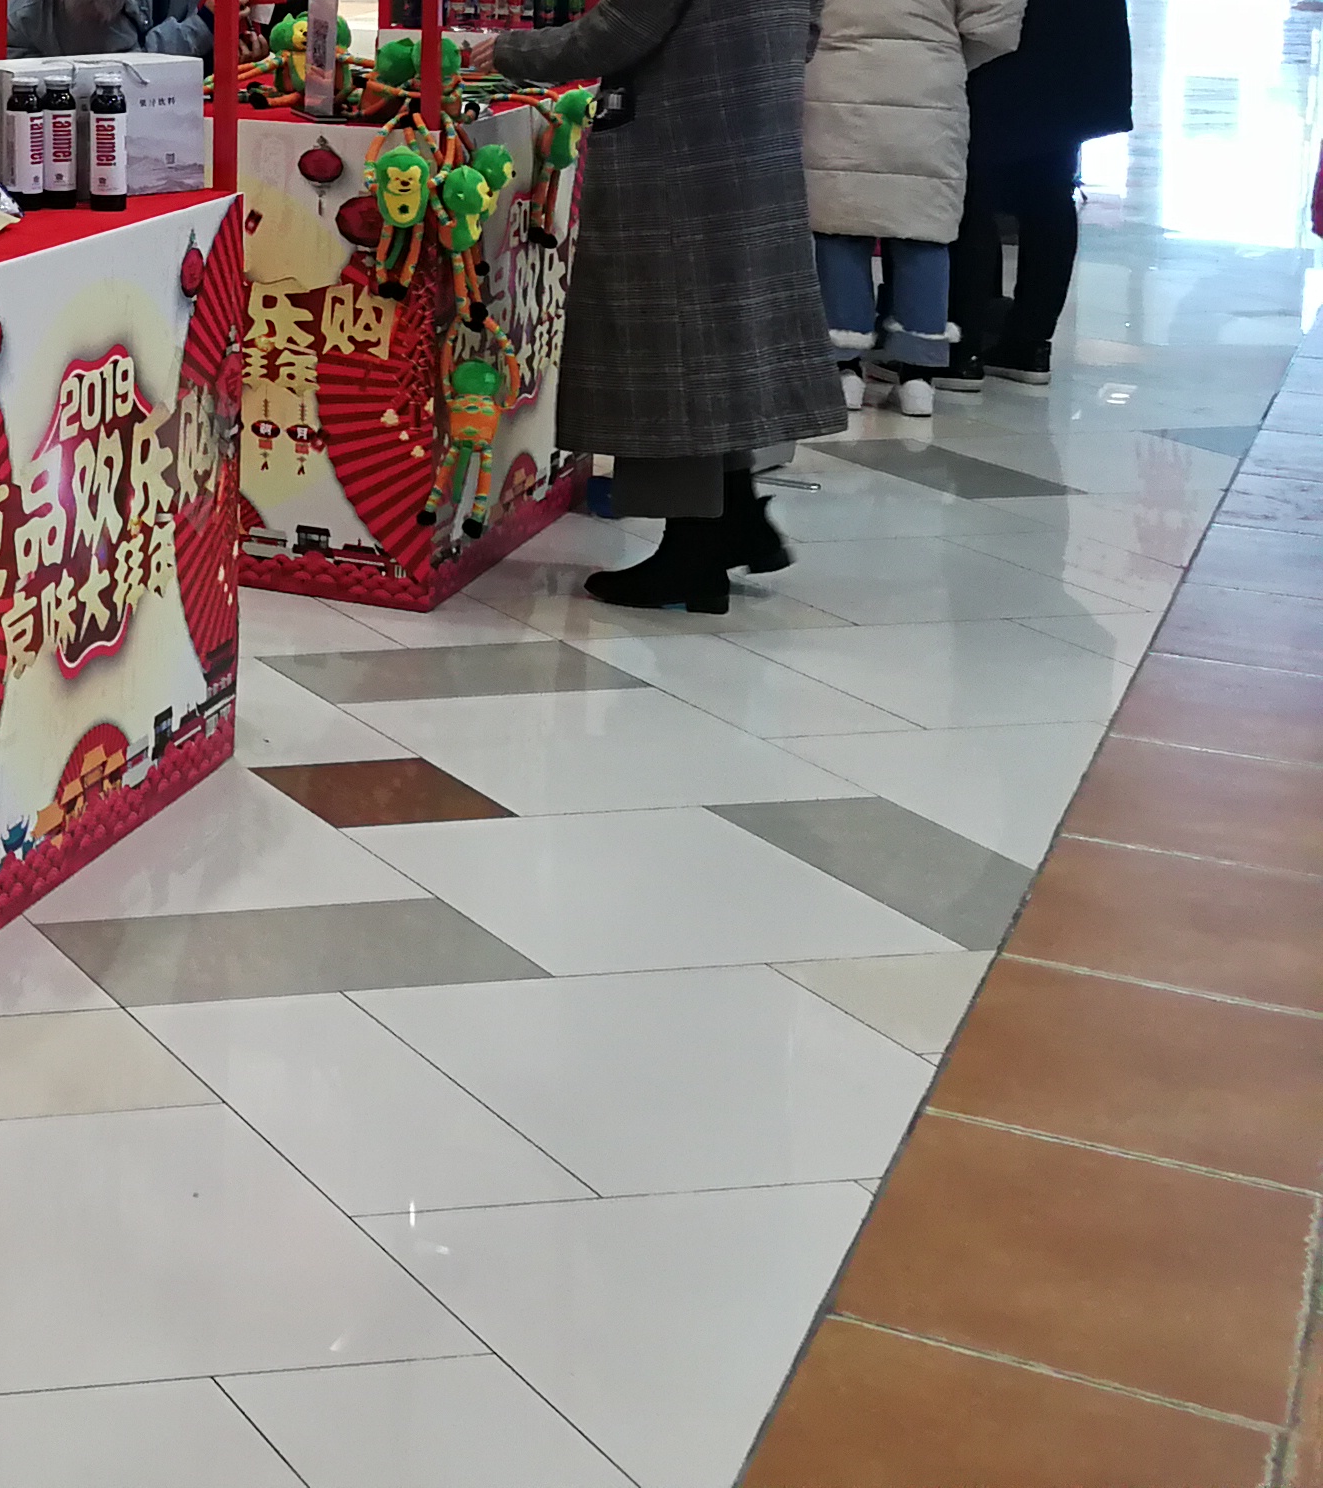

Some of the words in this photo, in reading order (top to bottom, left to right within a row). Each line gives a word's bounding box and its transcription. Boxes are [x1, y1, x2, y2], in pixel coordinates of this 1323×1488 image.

[52, 113, 73, 163] Lanmei
[95, 116, 117, 167] Lanmei
[59, 356, 135, 442] 2019
[1, 517, 176, 680] 京味大拜年
